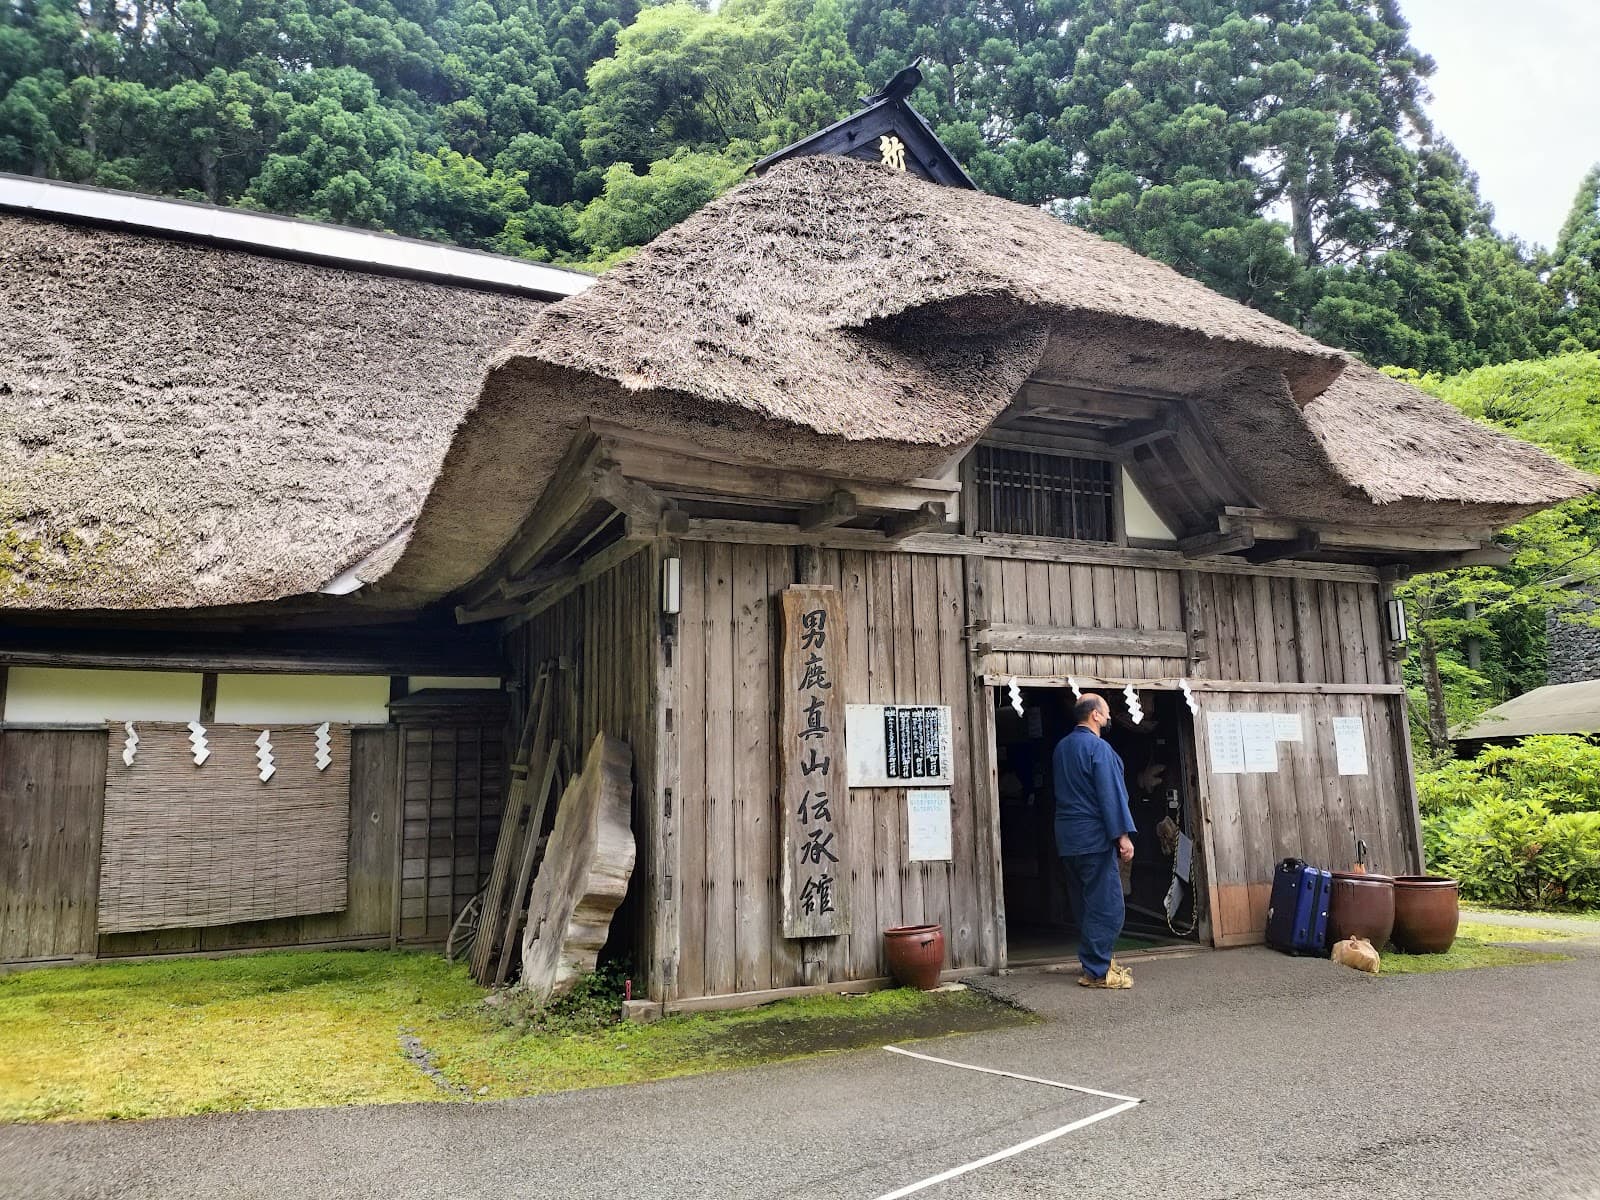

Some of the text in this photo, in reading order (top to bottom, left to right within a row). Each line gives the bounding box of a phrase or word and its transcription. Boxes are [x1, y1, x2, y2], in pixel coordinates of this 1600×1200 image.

[797, 608, 839, 917] 男鹿真山伝承館
